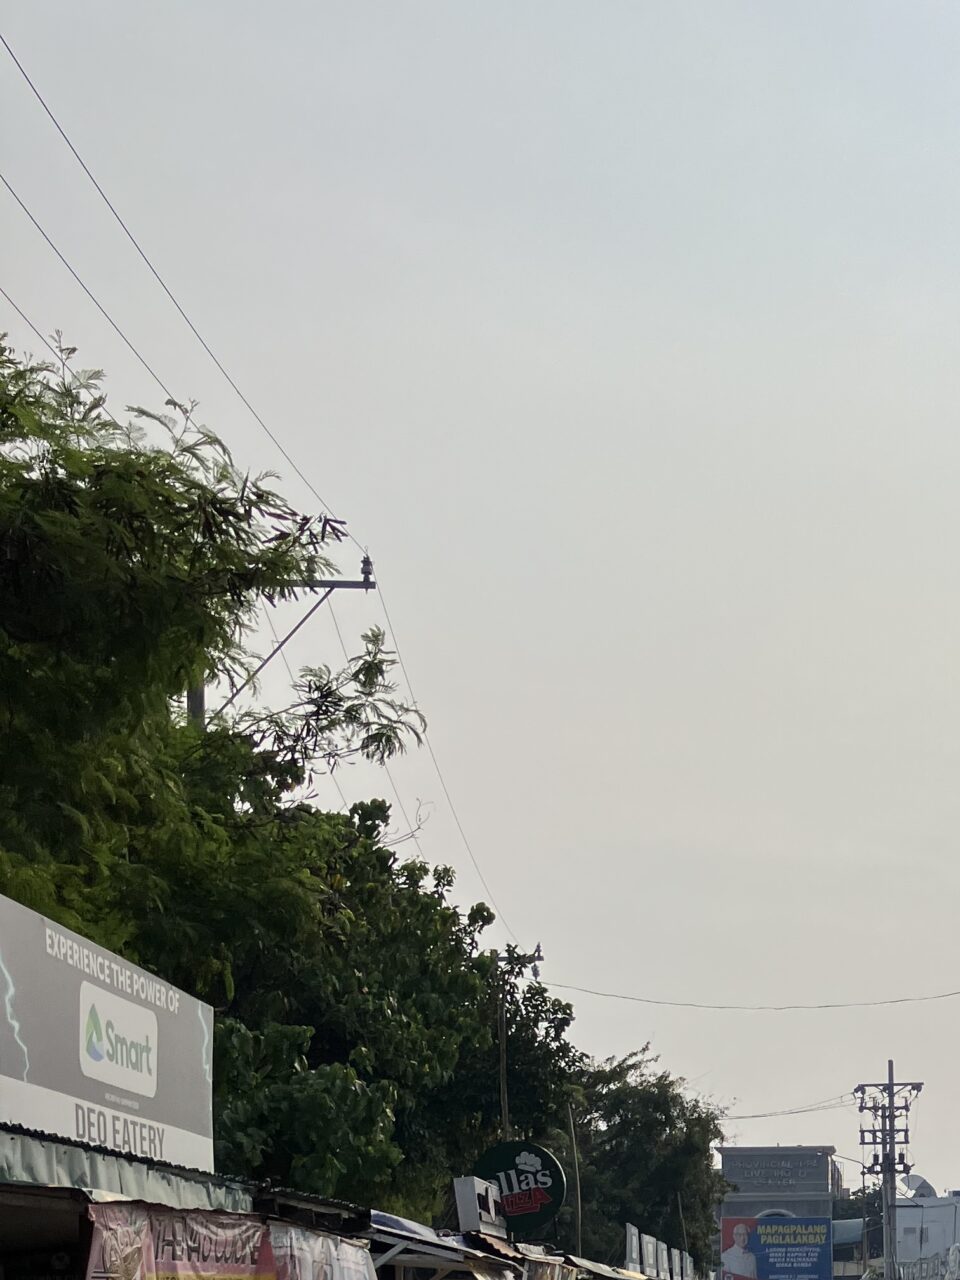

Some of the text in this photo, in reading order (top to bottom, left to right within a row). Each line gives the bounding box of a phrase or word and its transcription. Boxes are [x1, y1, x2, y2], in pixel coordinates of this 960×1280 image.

[45, 927, 180, 1015] EXPERIENCE THE POWER OF
[105, 1018, 153, 1077] Smart
[74, 1103, 165, 1159] DEO EATERY
[757, 1224, 827, 1235] MAPAGPALANG
[761, 1234, 827, 1245] PAGLALAKBAY
